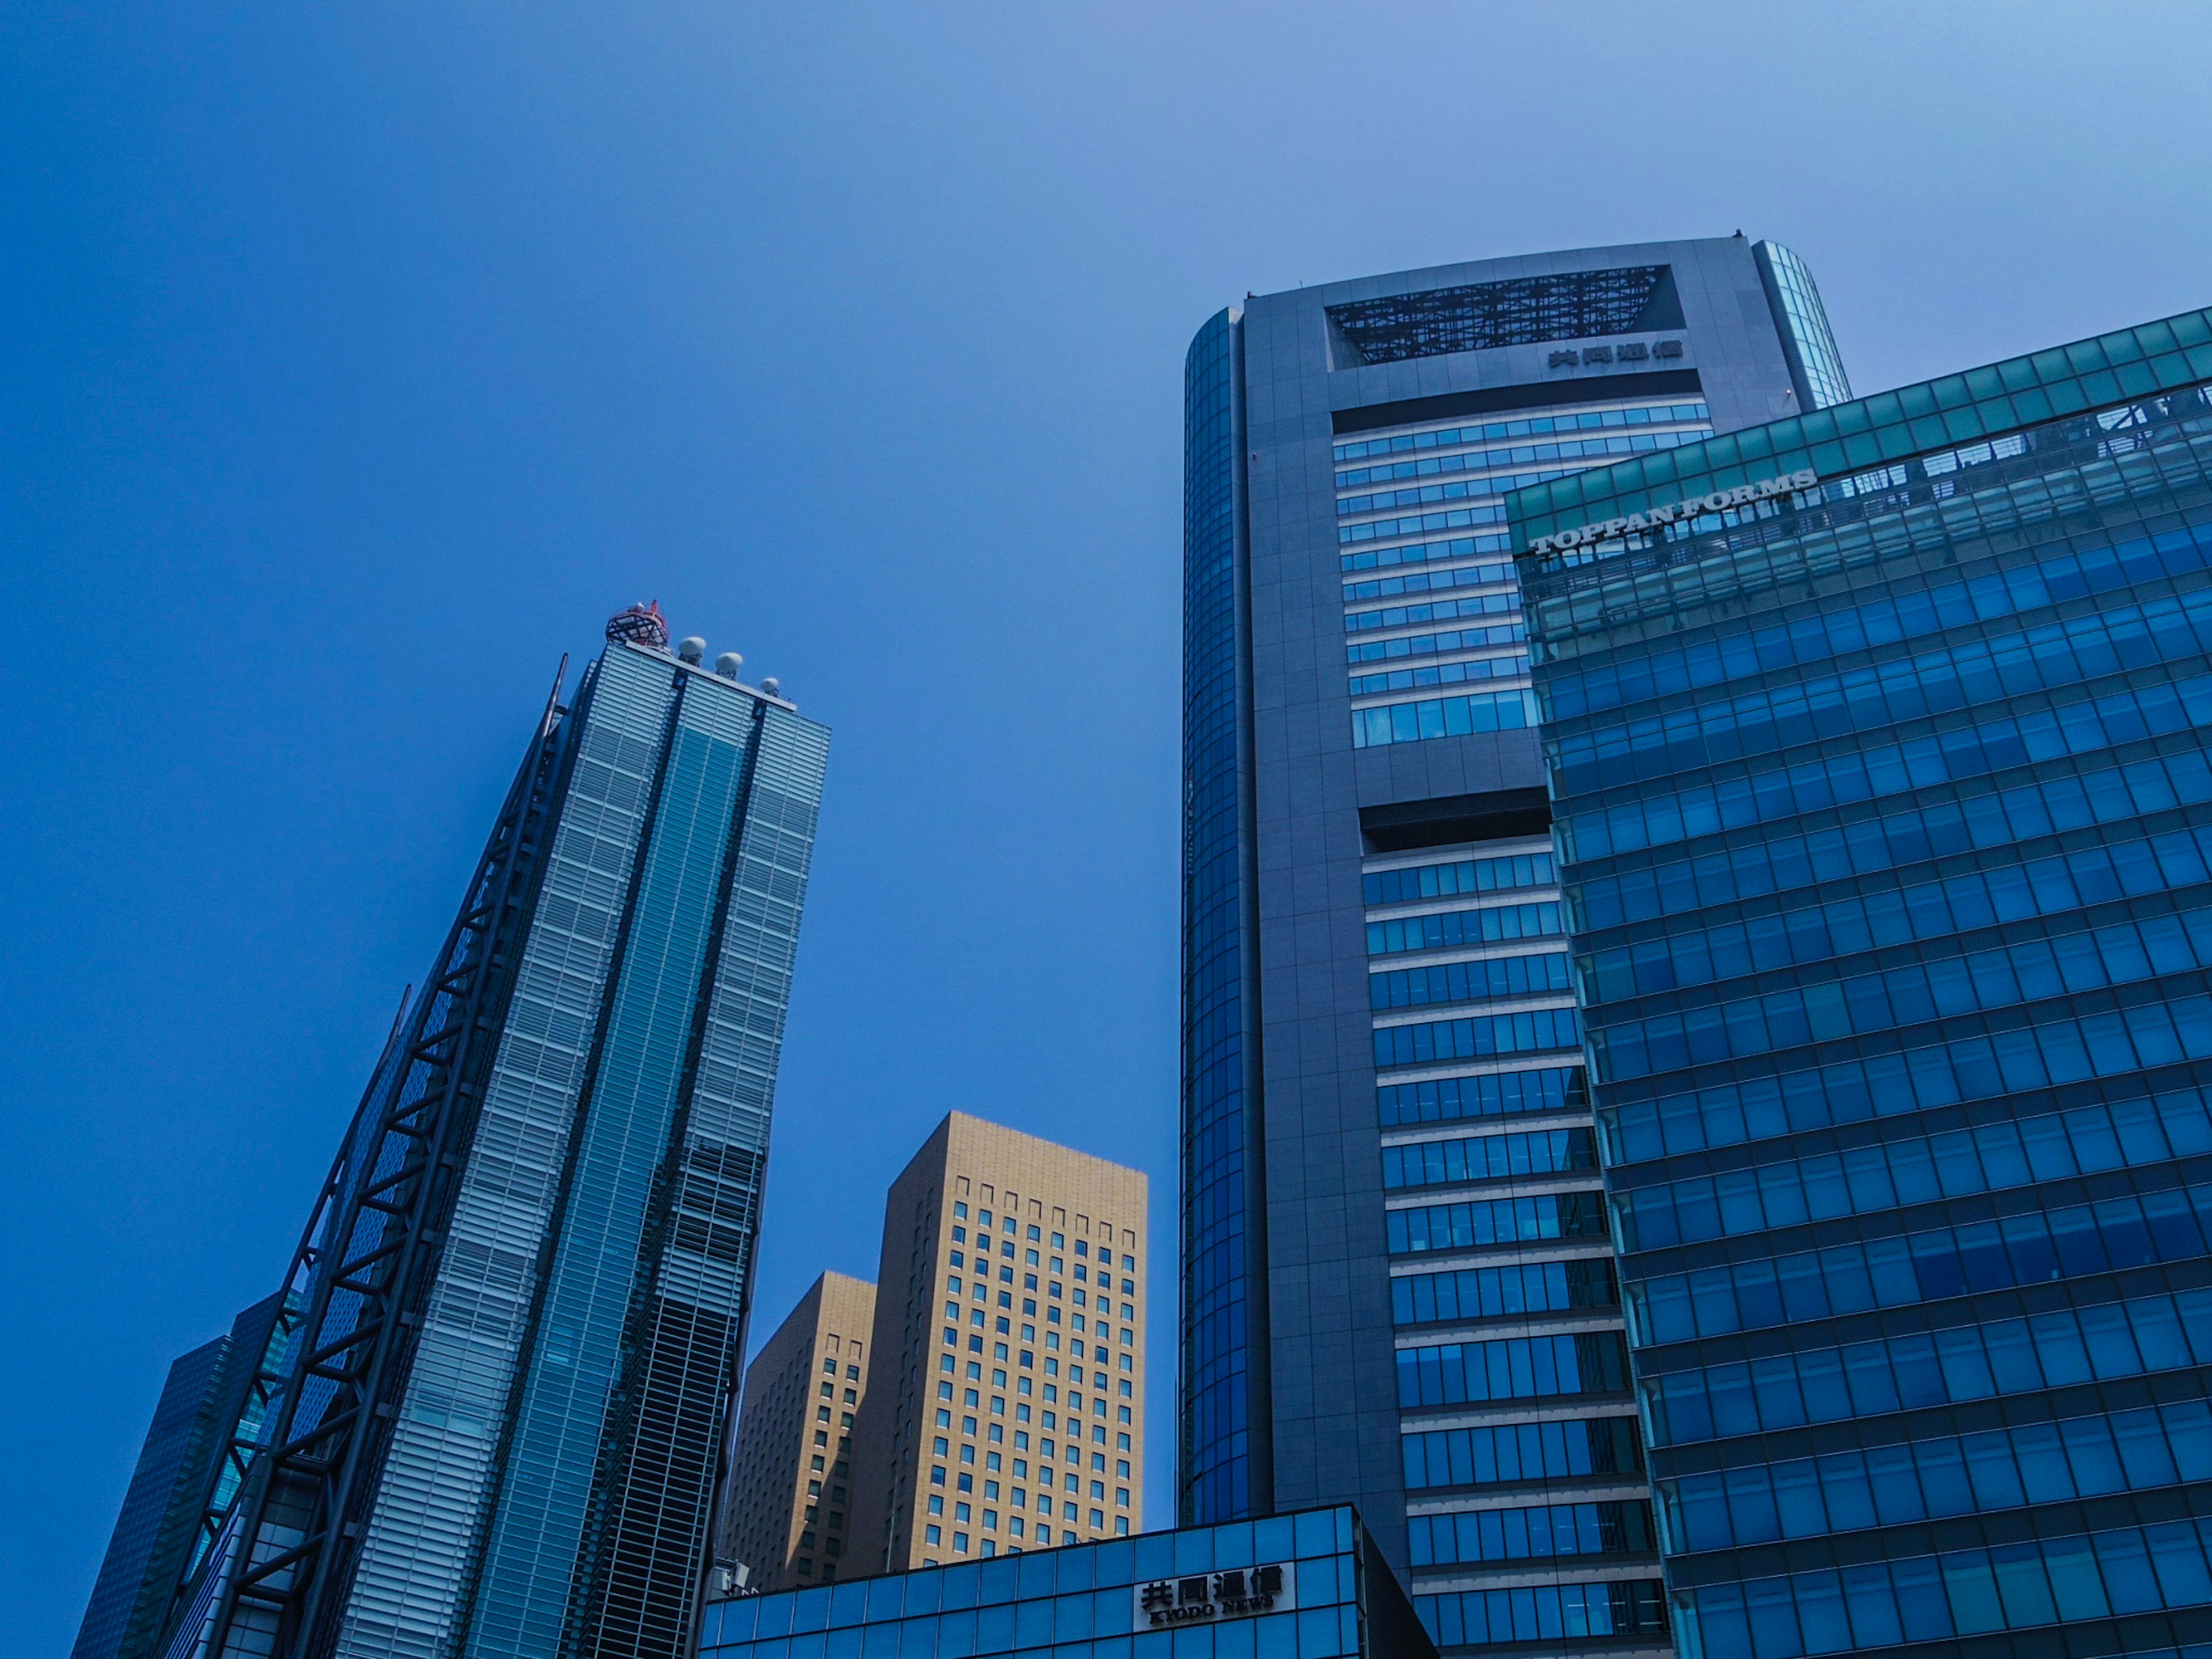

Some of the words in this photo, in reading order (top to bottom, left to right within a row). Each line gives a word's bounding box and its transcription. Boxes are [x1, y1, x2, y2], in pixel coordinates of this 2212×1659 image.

[1529, 505, 1675, 555] TOPPAN
[1679, 469, 1817, 517] FORMS
[1149, 1604, 1214, 1624] KYODO
[1222, 1595, 1274, 1613] NEWS
